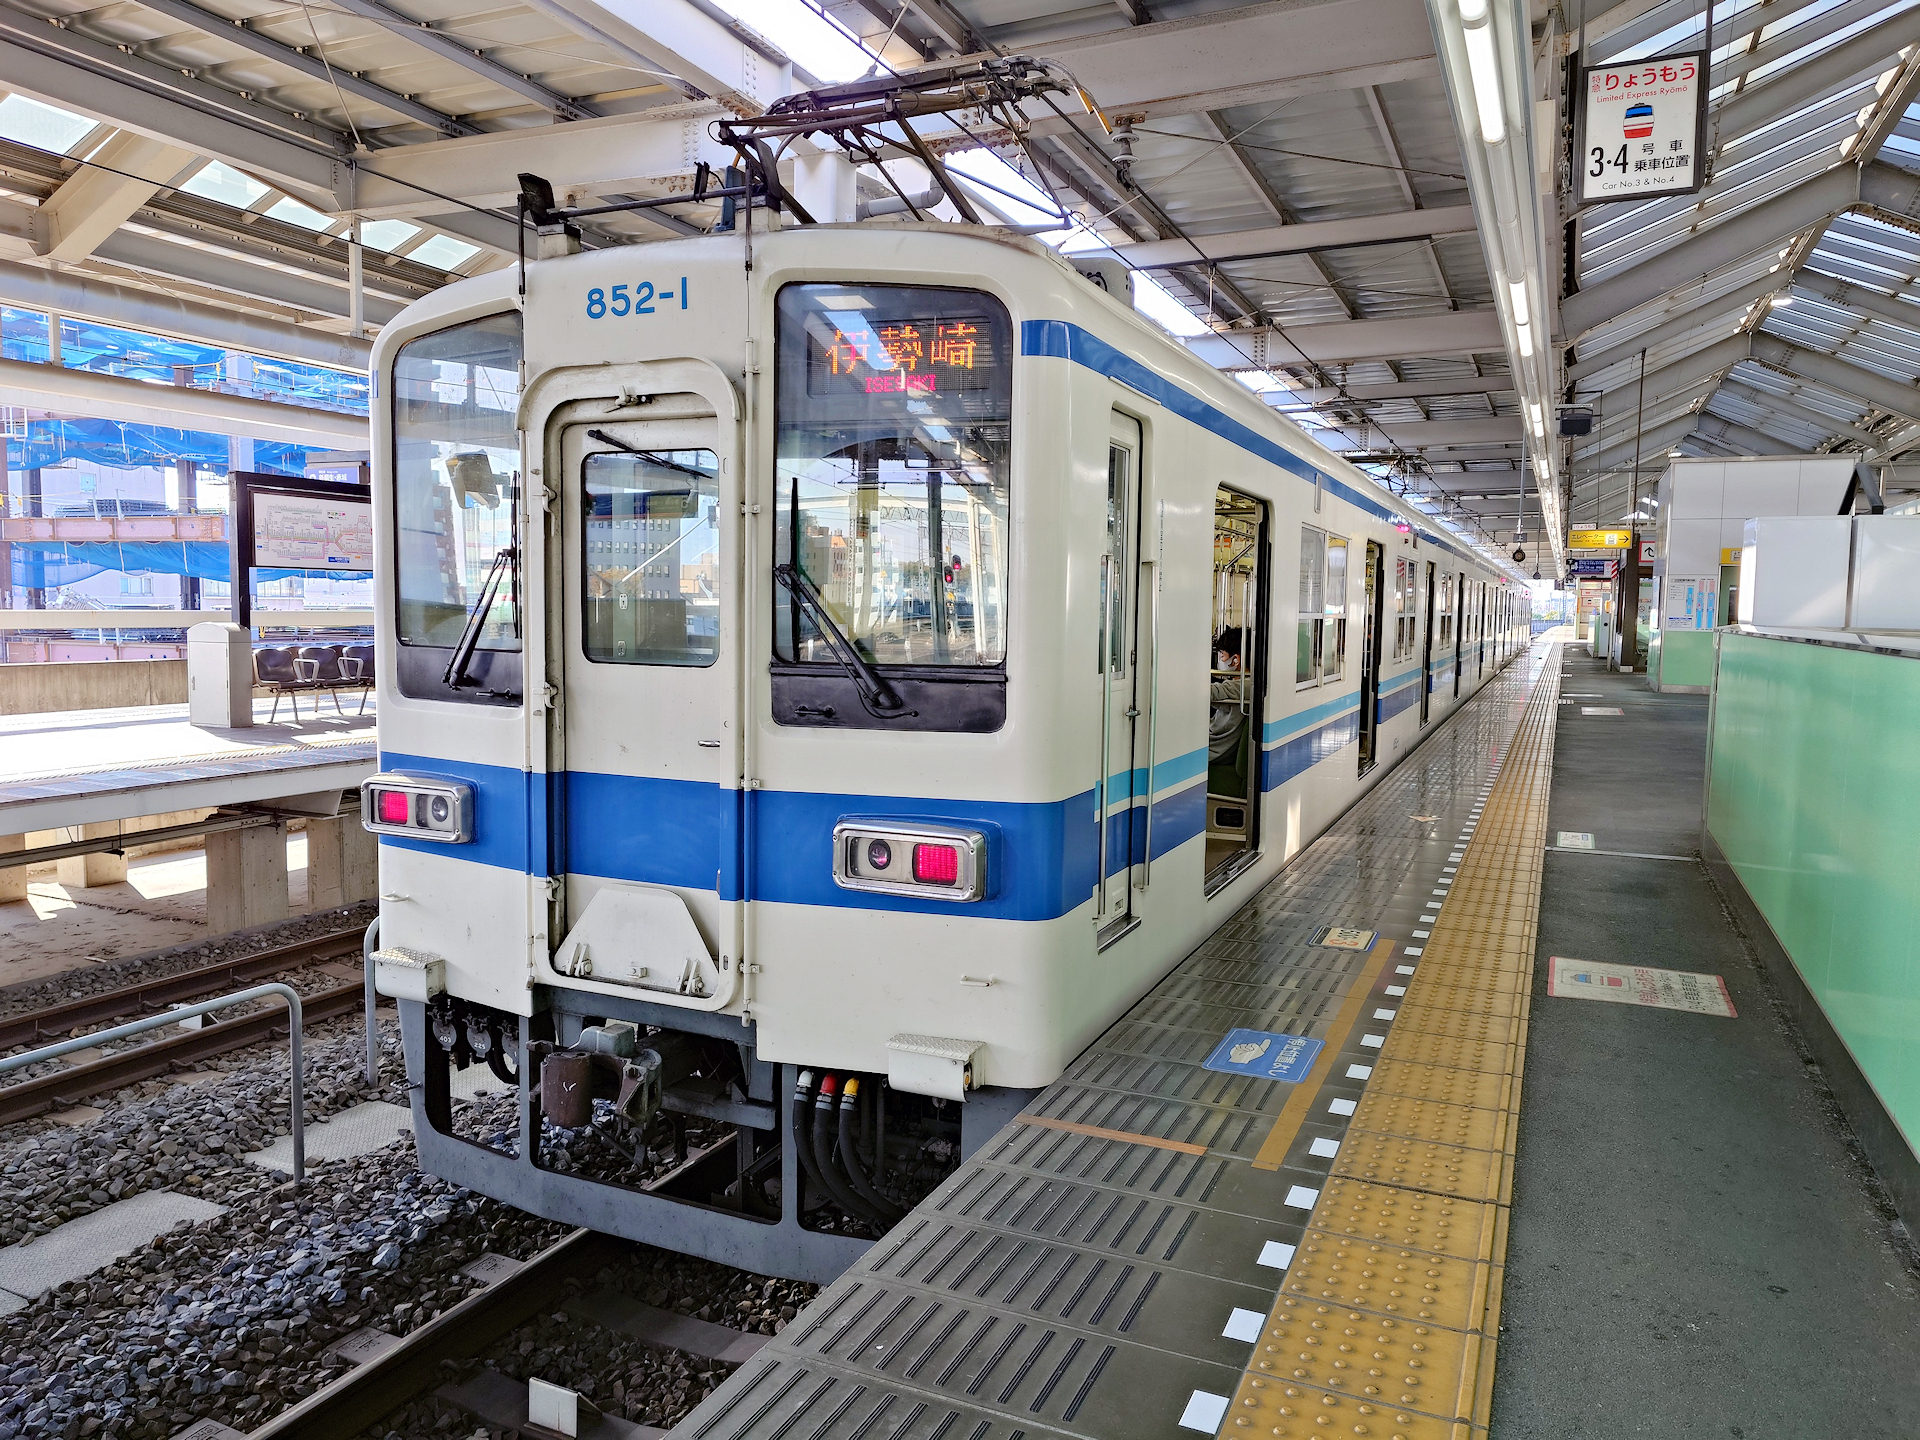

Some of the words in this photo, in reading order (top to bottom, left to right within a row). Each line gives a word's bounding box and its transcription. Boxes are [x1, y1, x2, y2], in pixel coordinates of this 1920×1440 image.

[1592, 75, 1601, 92] 特急
[1605, 62, 1696, 91] りょうもう
[1596, 93, 1624, 103] Limited
[1627, 90, 1657, 101] Express
[1660, 85, 1688, 96] Ryōmō
[1634, 155, 1690, 172] 乗車位置
[1620, 179, 1641, 188] No.3
[1653, 175, 1675, 184] No.4
[586, 276, 688, 320] 852-1
[825, 322, 978, 375] 伊勢崎
[865, 374, 937, 393] ISESAKI
[1267, 1038, 1308, 1077] 停止位置よし
